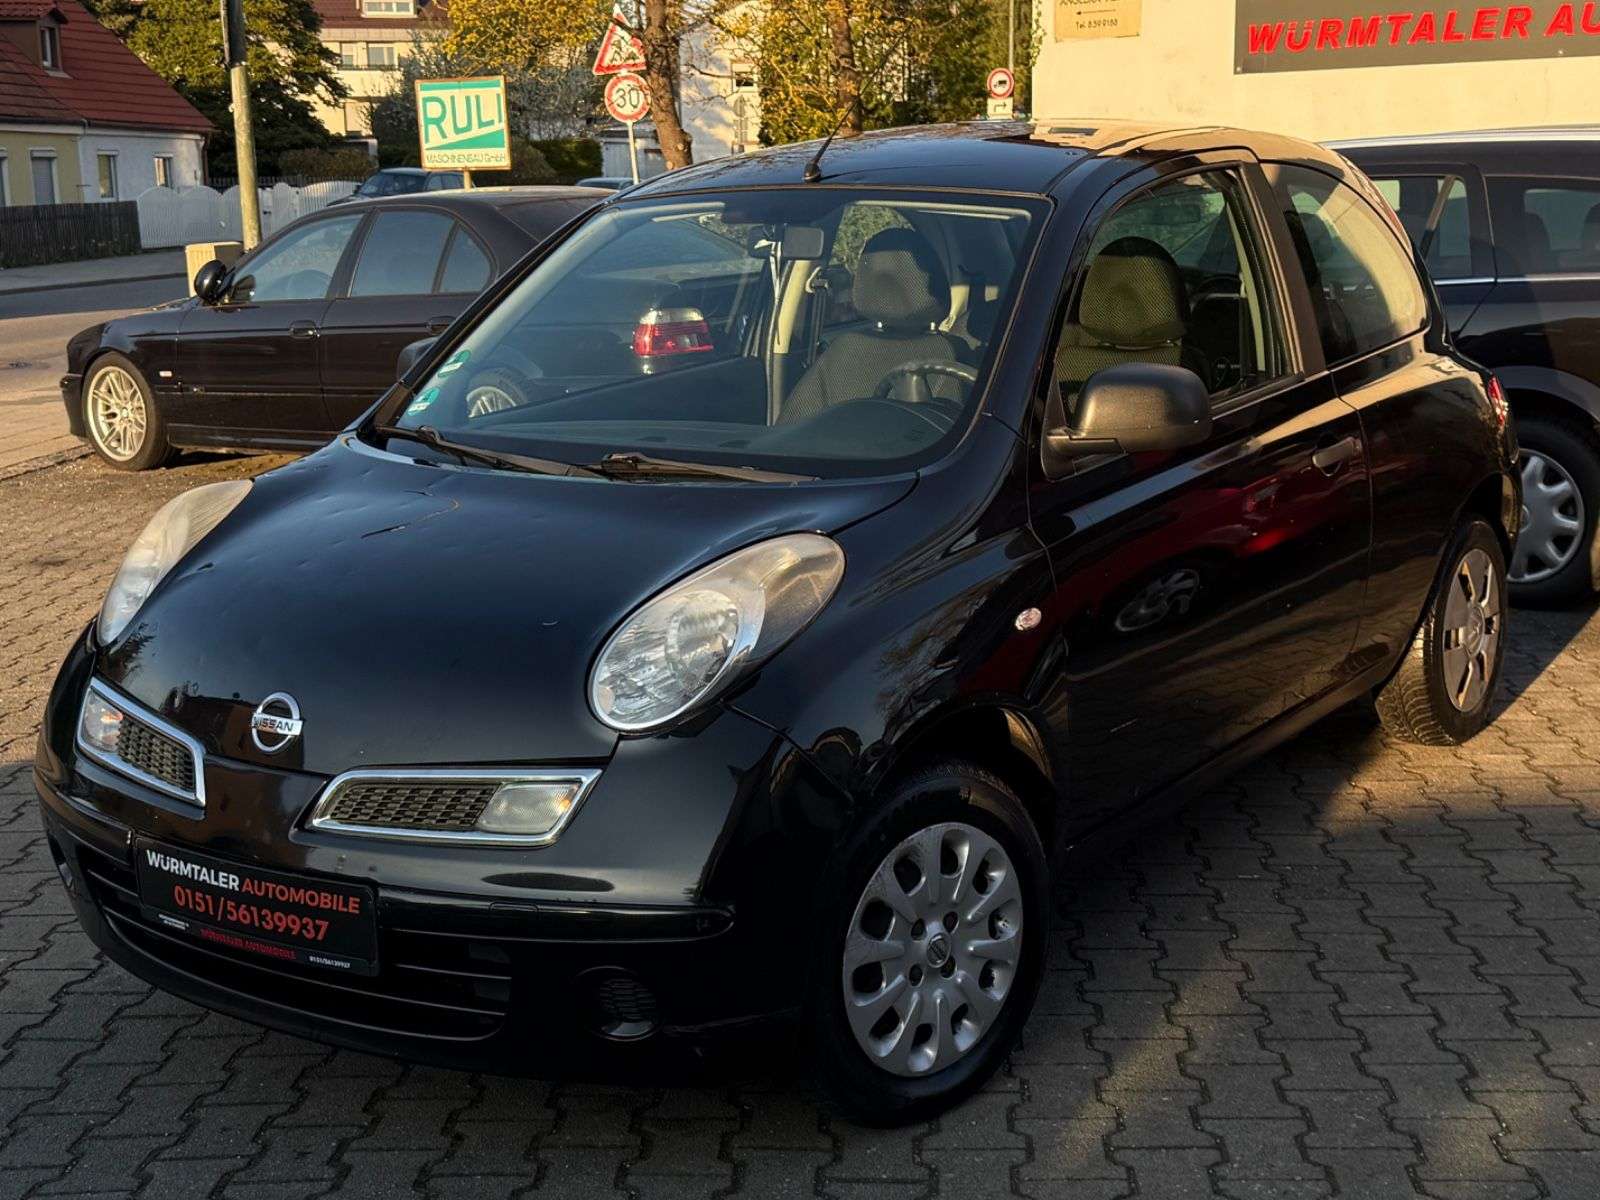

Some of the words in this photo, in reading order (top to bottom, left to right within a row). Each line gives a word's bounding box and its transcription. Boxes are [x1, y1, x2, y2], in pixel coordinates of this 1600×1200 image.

[1248, 6, 1534, 54] WÜRMTALER
[1544, 2, 1600, 37] AU
[422, 93, 503, 144] RULI
[615, 88, 640, 108] 30
[253, 715, 294, 732] NISSAN
[147, 849, 240, 892] WÜRMTALER
[241, 877, 361, 914] AUTOMOBILE
[173, 885, 329, 941] 0151/56139937
